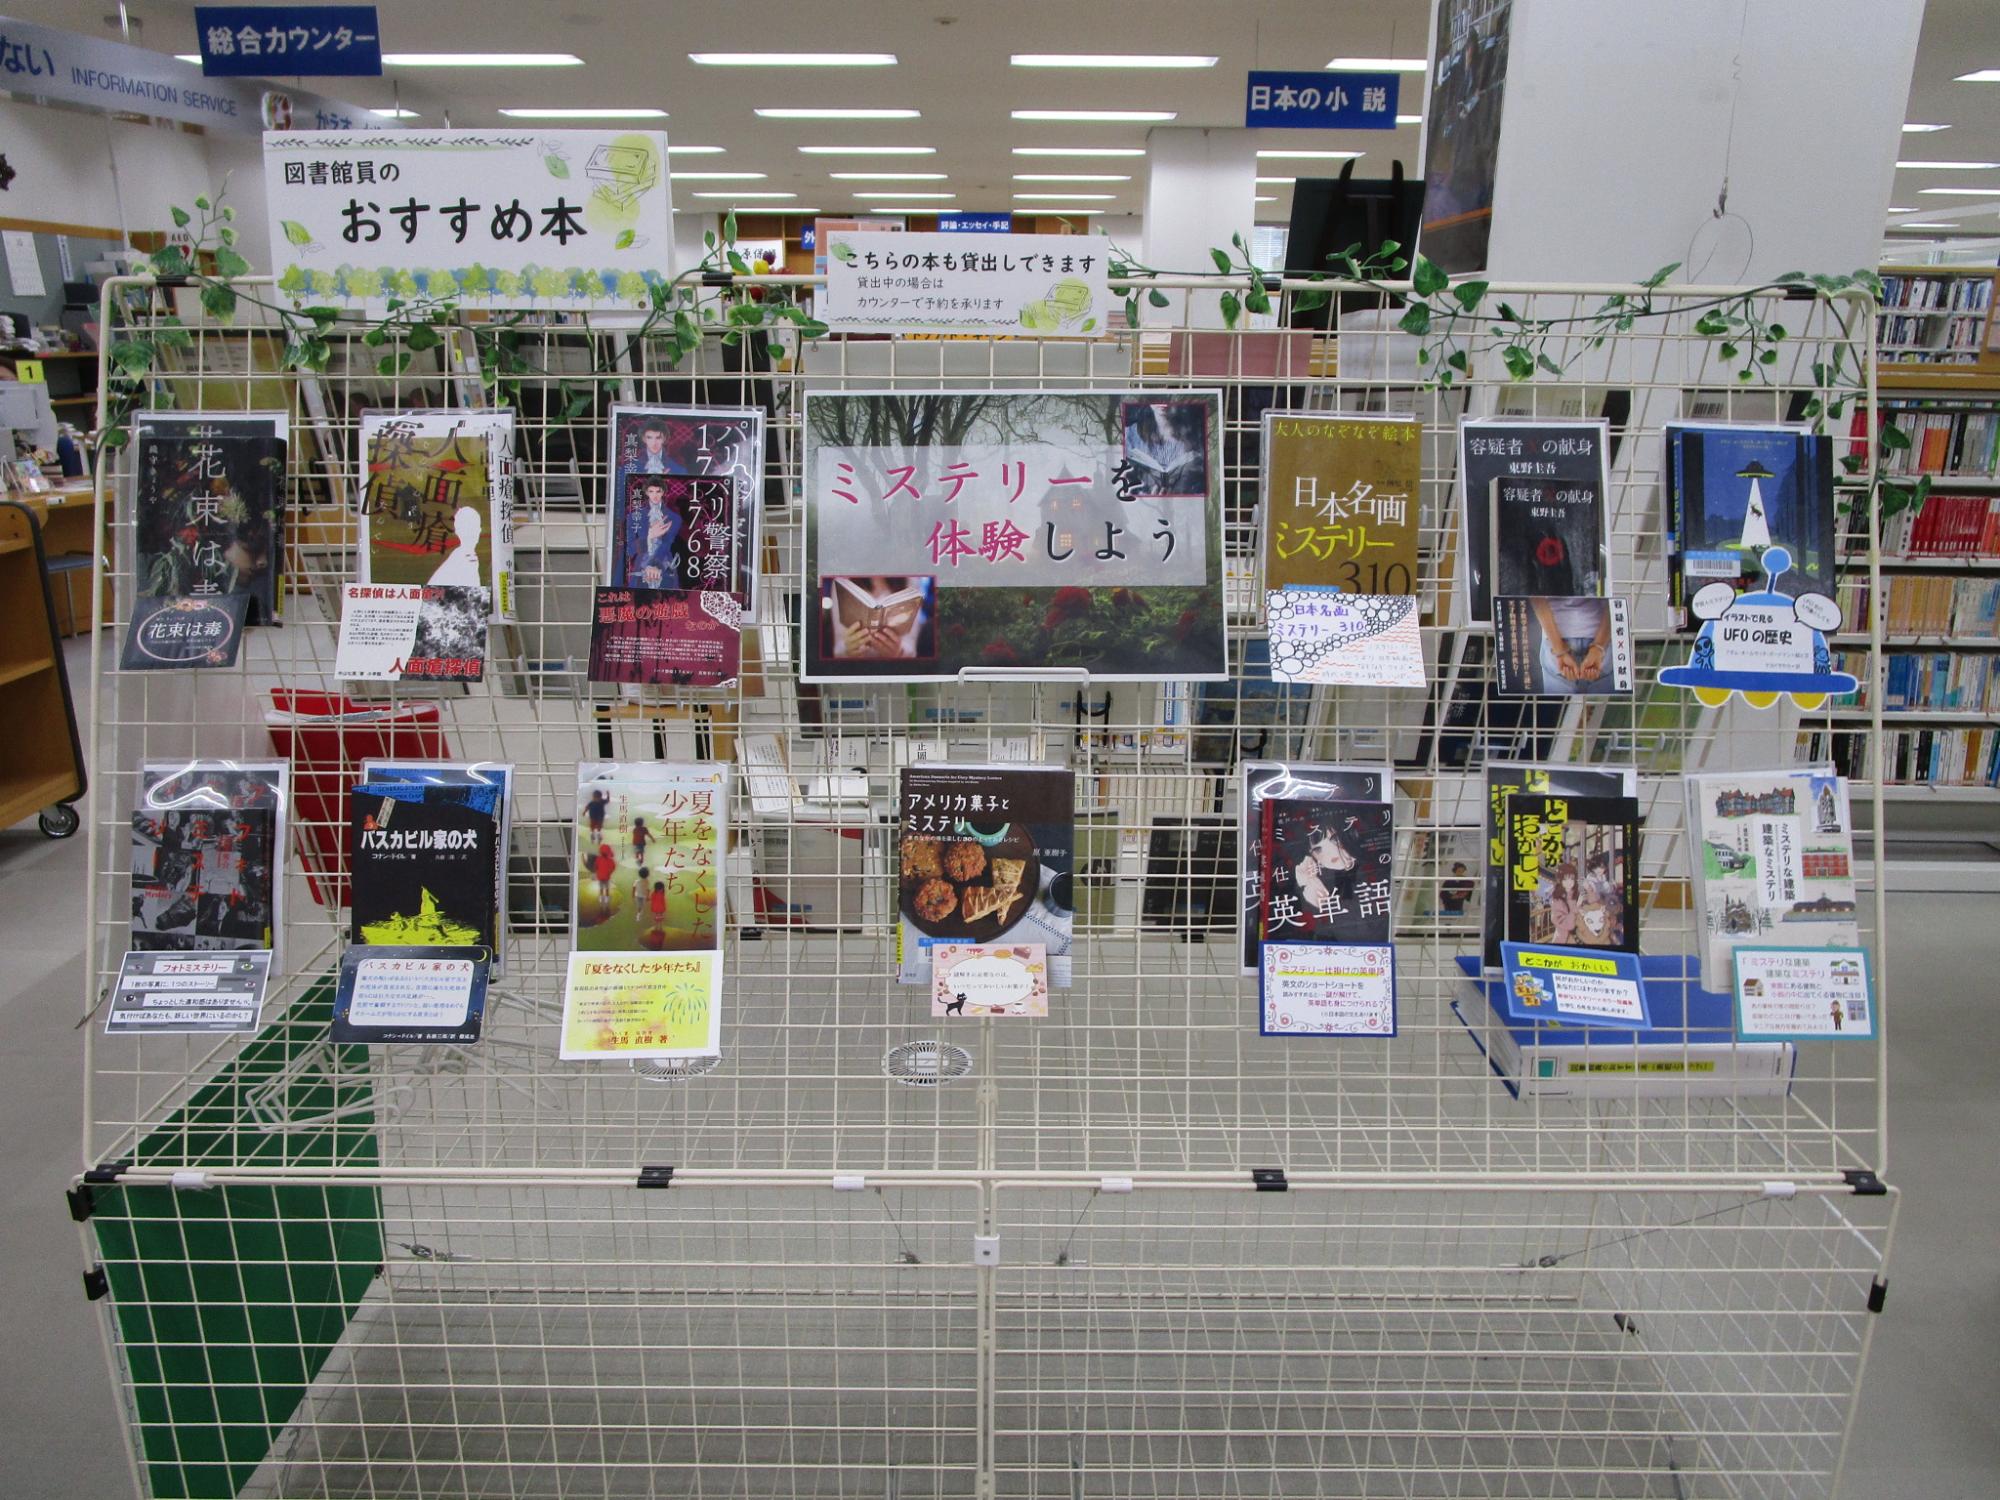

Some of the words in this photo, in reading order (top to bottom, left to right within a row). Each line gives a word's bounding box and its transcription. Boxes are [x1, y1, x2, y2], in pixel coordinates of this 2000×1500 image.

[206, 25, 376, 56] 総合カウンター
[71, 66, 178, 104] INFORMATION
[182, 89, 238, 117] SERVICE
[1250, 85, 1387, 113] 日本の小説
[284, 160, 400, 185] 図書館員の
[341, 196, 588, 246] おすすめ本
[940, 219, 1010, 231] 評論・エッセイ・手記
[845, 251, 1096, 274] こちらの本も貸出しできます
[857, 276, 944, 290] 貸出中の場合は
[857, 296, 1004, 311] カウンターで予約を承ります
[1274, 421, 1416, 442] 大人のなぞなぞ絵本
[831, 459, 1144, 505] ミステリーを
[1294, 476, 1409, 527] 日本名画
[703, 478, 732, 580] パリ警察
[1275, 522, 1395, 561] ミステリー
[925, 518, 1178, 567] 体験しよう
[1339, 561, 1412, 595] 310
[1294, 603, 1350, 617] 日本名画
[1722, 613, 1774, 625] イラストで見る
[148, 620, 222, 640] 花束は毒
[1277, 623, 1329, 637] ミステリー
[1339, 621, 1364, 633] 310
[1722, 628, 1793, 645] UFOの歴史
[907, 793, 1010, 812] アメリカ菓子と
[907, 814, 965, 833] ミステリ
[360, 828, 478, 851] バスカビル家の犬
[661, 790, 689, 896] 少年たち
[1513, 813, 1540, 889] おかしい
[688, 789, 715, 940] 夏をなくした
[1762, 822, 1776, 903] 建築なミステリ
[1781, 822, 1796, 902] ミステリな建築
[1267, 878, 1392, 933] 英単語
[162, 962, 229, 973] フォトミステリー
[363, 960, 470, 973] バスカビル家の犬
[584, 962, 701, 975] 『夏をなくした少年たち』
